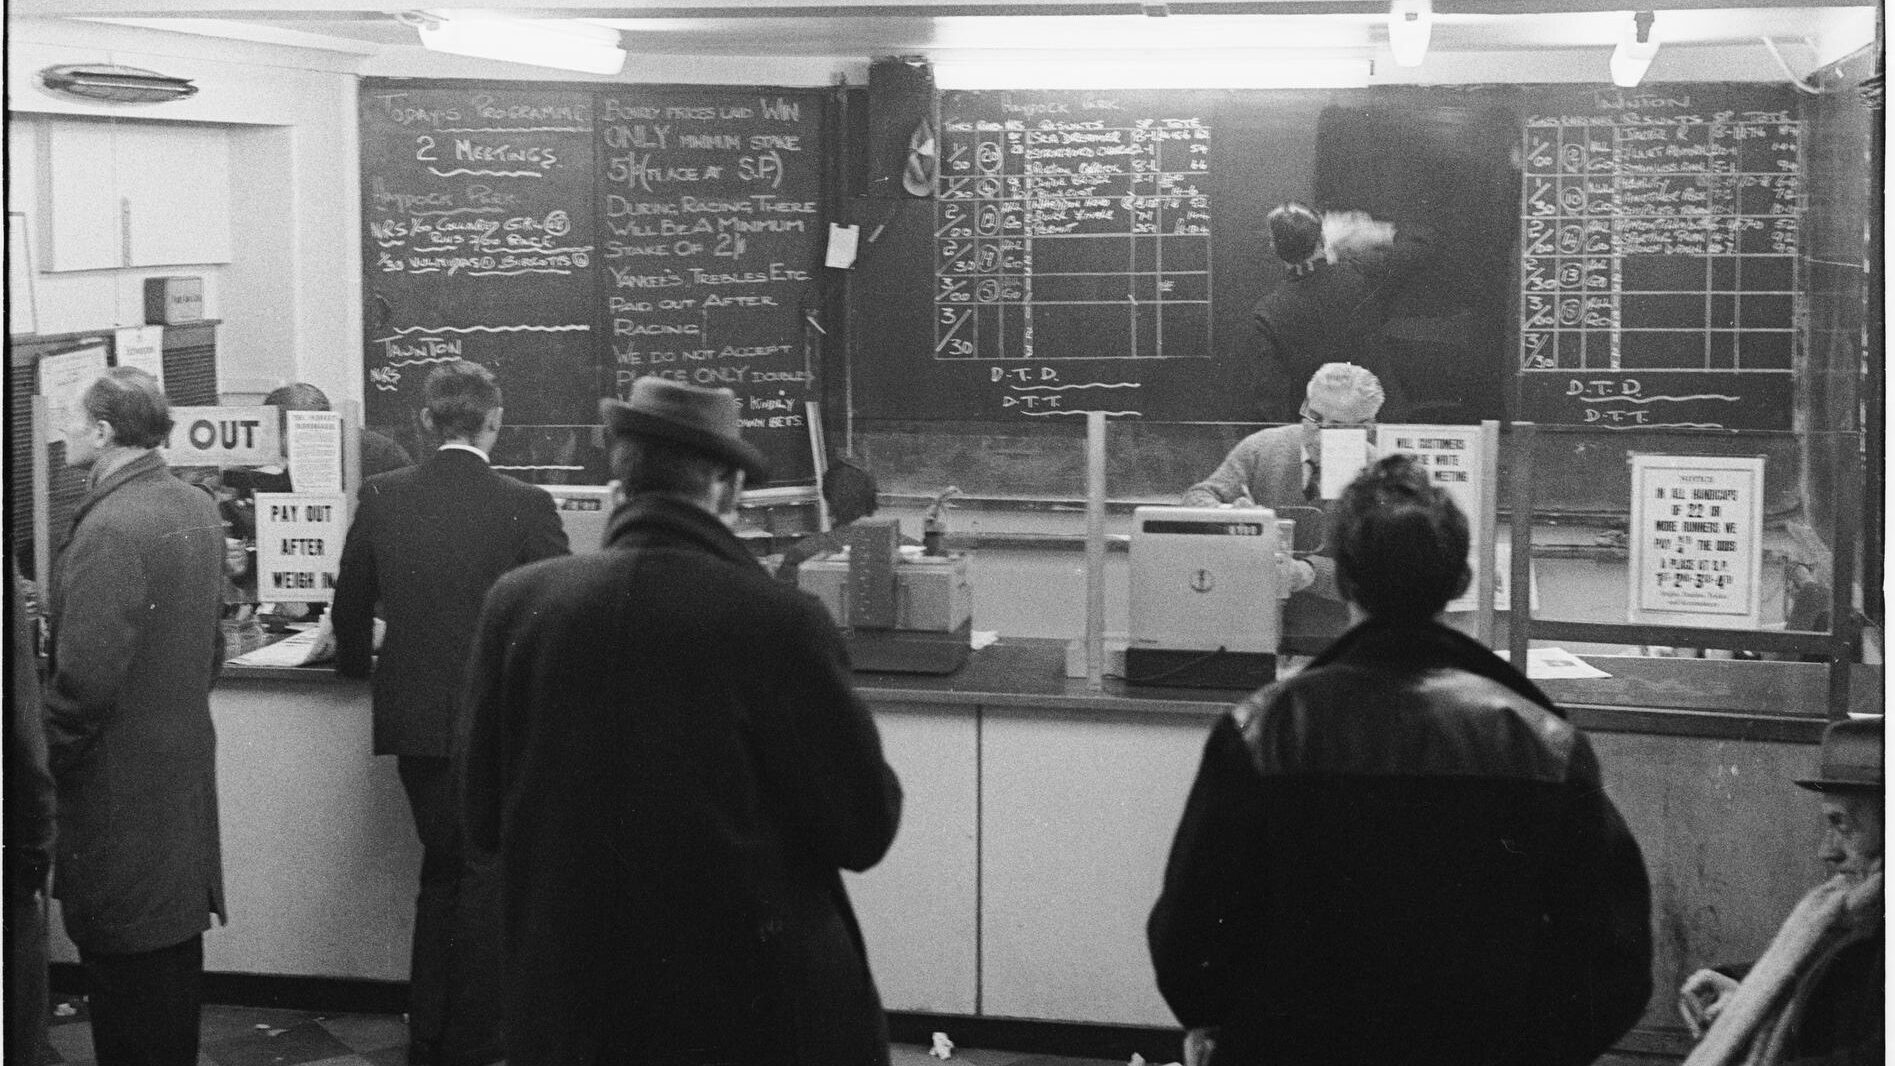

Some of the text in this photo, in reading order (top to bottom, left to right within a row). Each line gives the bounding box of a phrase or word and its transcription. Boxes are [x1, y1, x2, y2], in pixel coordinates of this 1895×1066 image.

[759, 98, 798, 121] WIN
[603, 124, 671, 149] ONLY
[416, 135, 437, 160] 2
[751, 195, 817, 213] THERE
[695, 217, 713, 233] A
[673, 241, 703, 256] OF
[609, 294, 778, 313] PAID OUT AFTER
[613, 318, 699, 335] RACING
[613, 342, 792, 364] WE DO NOT ACCEPT
[694, 365, 750, 383] ONLY
[190, 419, 259, 450] OUT
[1418, 438, 1465, 451] CUSTOMERS
[1434, 470, 1469, 483] MEETING
[270, 505, 332, 522] PAY OUT
[1655, 520, 1679, 533] MORE
[1683, 521, 1721, 534] RUNNERS
[279, 538, 325, 555] AFTER
